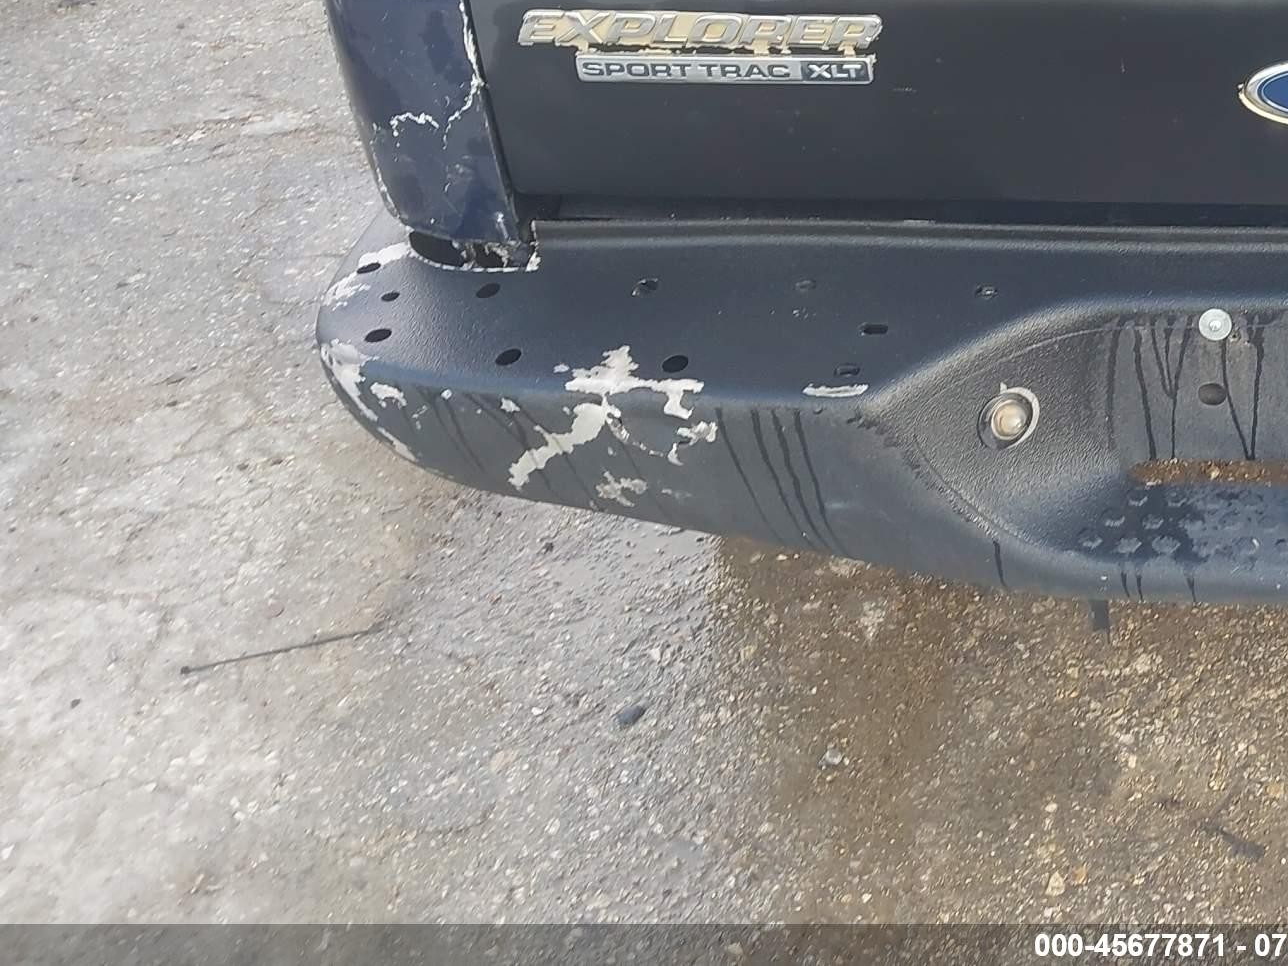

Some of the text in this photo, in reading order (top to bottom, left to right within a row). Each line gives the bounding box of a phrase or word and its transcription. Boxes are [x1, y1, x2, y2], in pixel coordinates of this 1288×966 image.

[519, 10, 881, 48] EXPLORER
[582, 62, 862, 79] SPORT TRAC XLT
